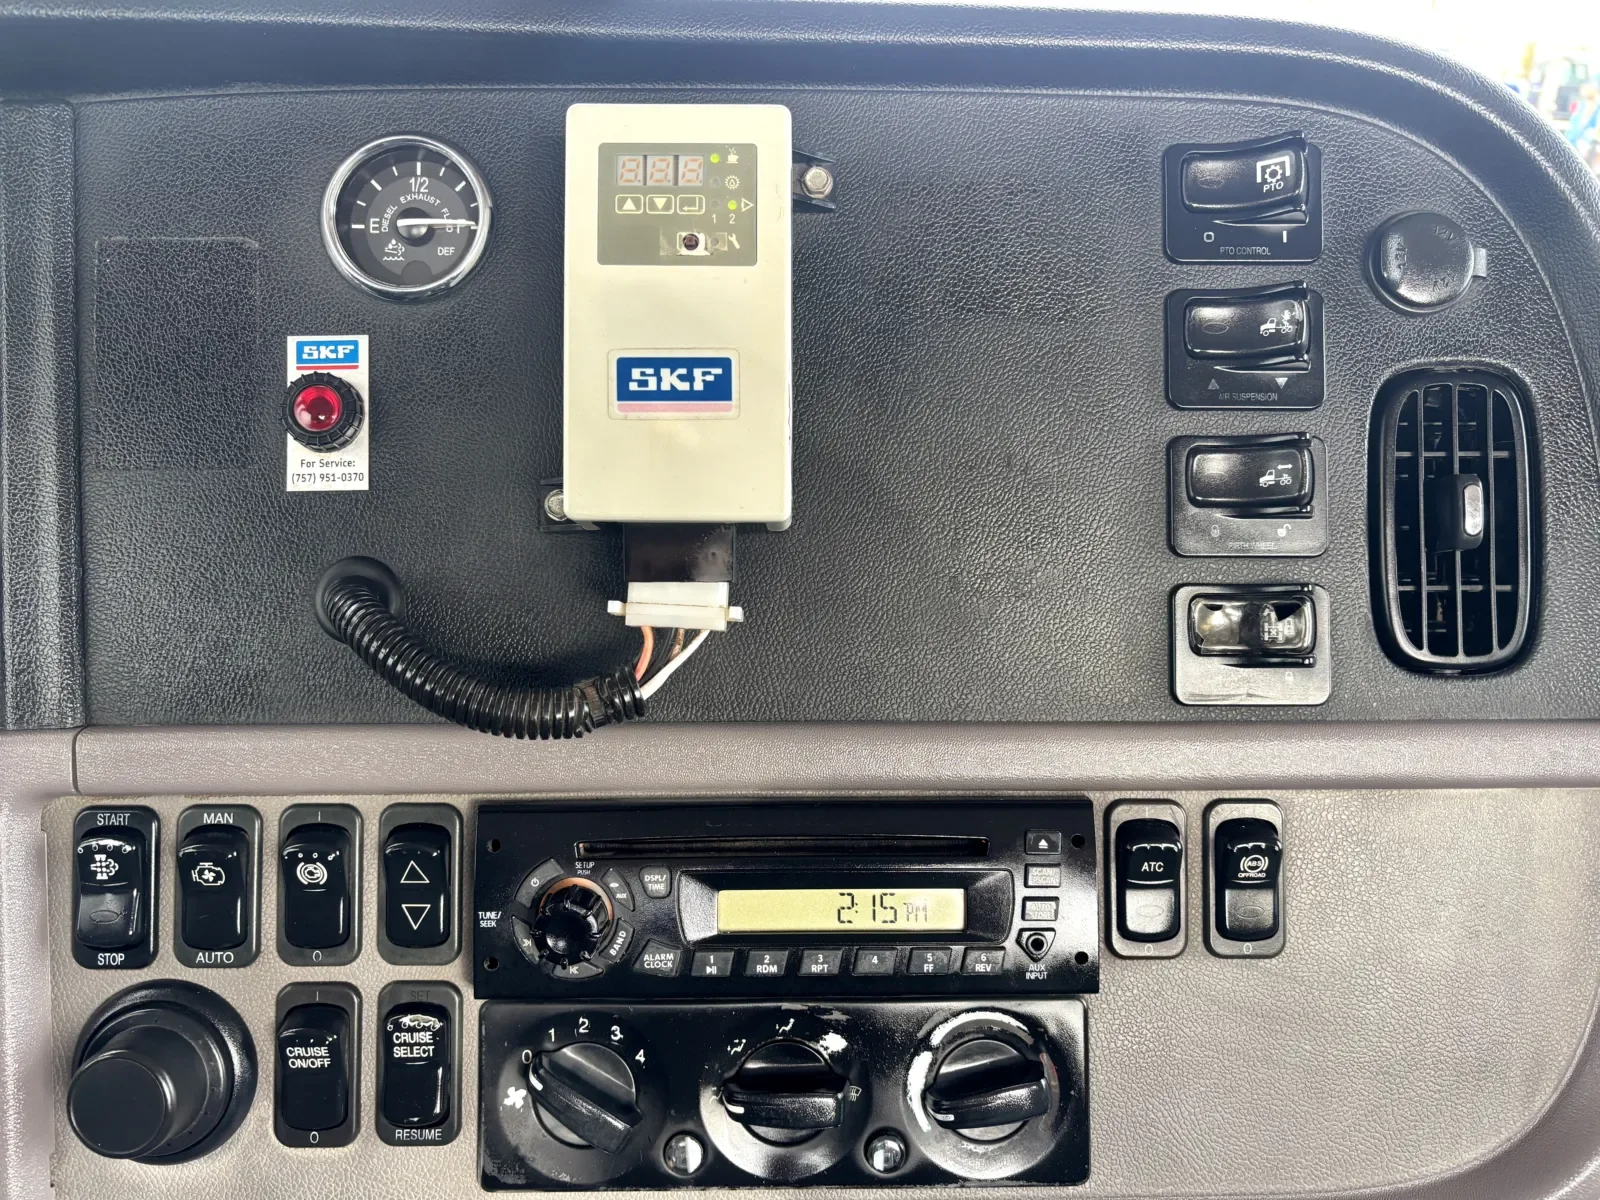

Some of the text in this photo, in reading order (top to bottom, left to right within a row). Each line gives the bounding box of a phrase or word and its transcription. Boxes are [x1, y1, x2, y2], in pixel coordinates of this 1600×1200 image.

[409, 177, 429, 193] 1/2
[1263, 181, 1284, 193] PTO
[381, 205, 398, 232] DIESEL
[400, 193, 441, 207] EXHAUST
[712, 213, 736, 224] 1 2
[370, 218, 380, 234] E
[437, 246, 456, 256] DEF
[1220, 246, 1271, 255] PTO CONTROL
[302, 345, 355, 360] SKF
[629, 368, 723, 391] SKF
[1219, 392, 1278, 401] AIR SUSPENSION
[300, 457, 356, 468] For Service:
[291, 472, 365, 485] (757) 951-0370
[97, 813, 131, 826] START
[203, 812, 234, 825] MAN
[575, 861, 595, 869] SETUP
[1141, 861, 1164, 873] ATC
[644, 874, 667, 882] DSPL/
[837, 892, 898, 924] 2:15
[478, 911, 502, 920] TUNE/
[479, 920, 497, 928] SEEK
[608, 930, 627, 957] BAND
[97, 952, 125, 966] STOP
[195, 951, 234, 964] AUTO
[643, 953, 675, 961] ALARM
[709, 955, 714, 963] 1
[763, 954, 770, 963] 2
[817, 954, 823, 963] 3
[871, 956, 878, 964] 4
[926, 953, 933, 962] 5
[980, 953, 987, 962] 6
[644, 961, 674, 969] CLOCK
[756, 965, 778, 973] RDM
[811, 965, 829, 973] RPT
[924, 964, 935, 973] FF
[975, 964, 992, 973] REV
[1028, 963, 1046, 972] AUX
[1025, 972, 1048, 980] INPUT
[578, 1018, 590, 1034] 2
[393, 1031, 434, 1044] CRUISE
[548, 1027, 556, 1042] 1
[610, 1025, 621, 1041] 3
[286, 1046, 330, 1057] CRUISE
[393, 1046, 435, 1058] SELECT
[521, 1050, 533, 1064] 0
[634, 1049, 646, 1064] 4
[288, 1058, 331, 1069] ON/OFF
[395, 1128, 443, 1141] RESUME
